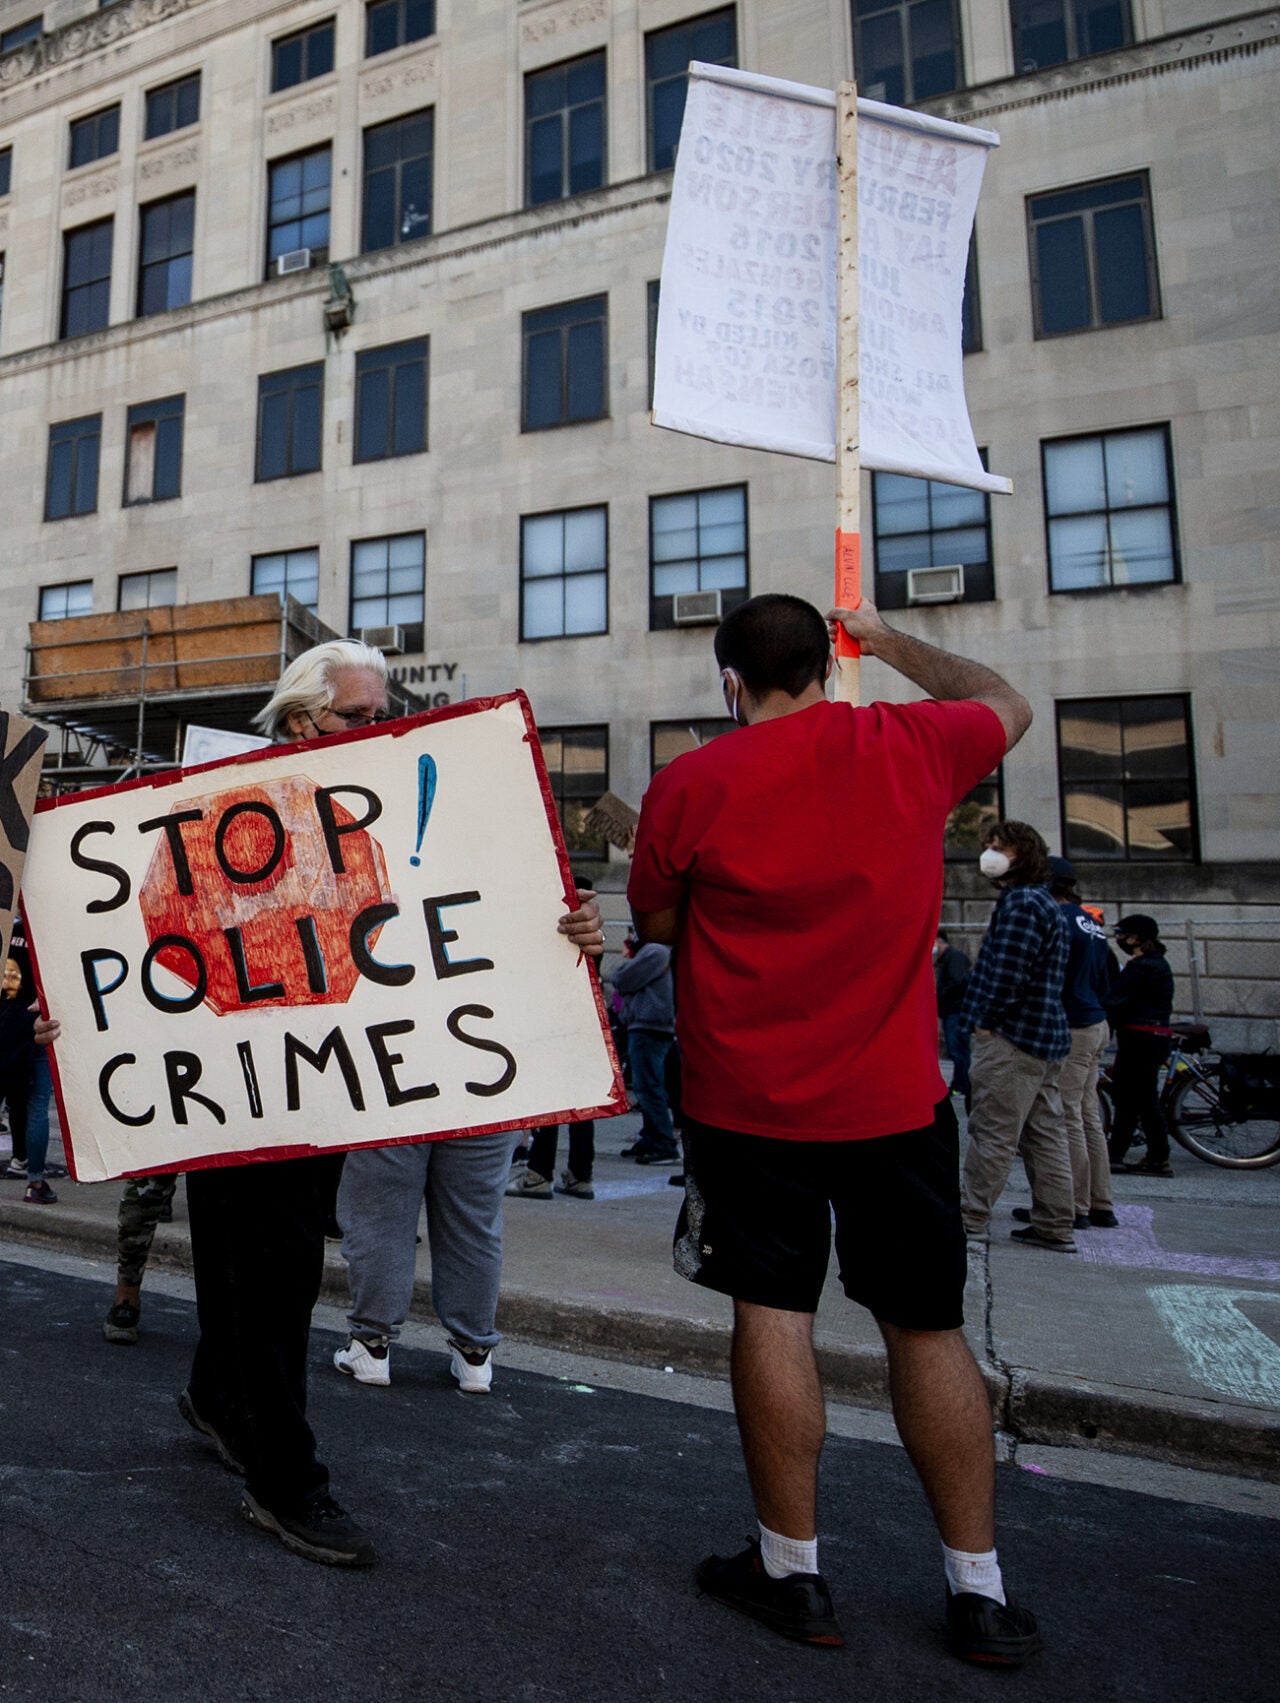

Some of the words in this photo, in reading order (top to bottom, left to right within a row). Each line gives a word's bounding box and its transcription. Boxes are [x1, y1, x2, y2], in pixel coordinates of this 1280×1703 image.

[842, 546, 856, 574] ALVIN
[81, 891, 494, 1031] POLICE
[98, 1003, 517, 1127] CRIMES
